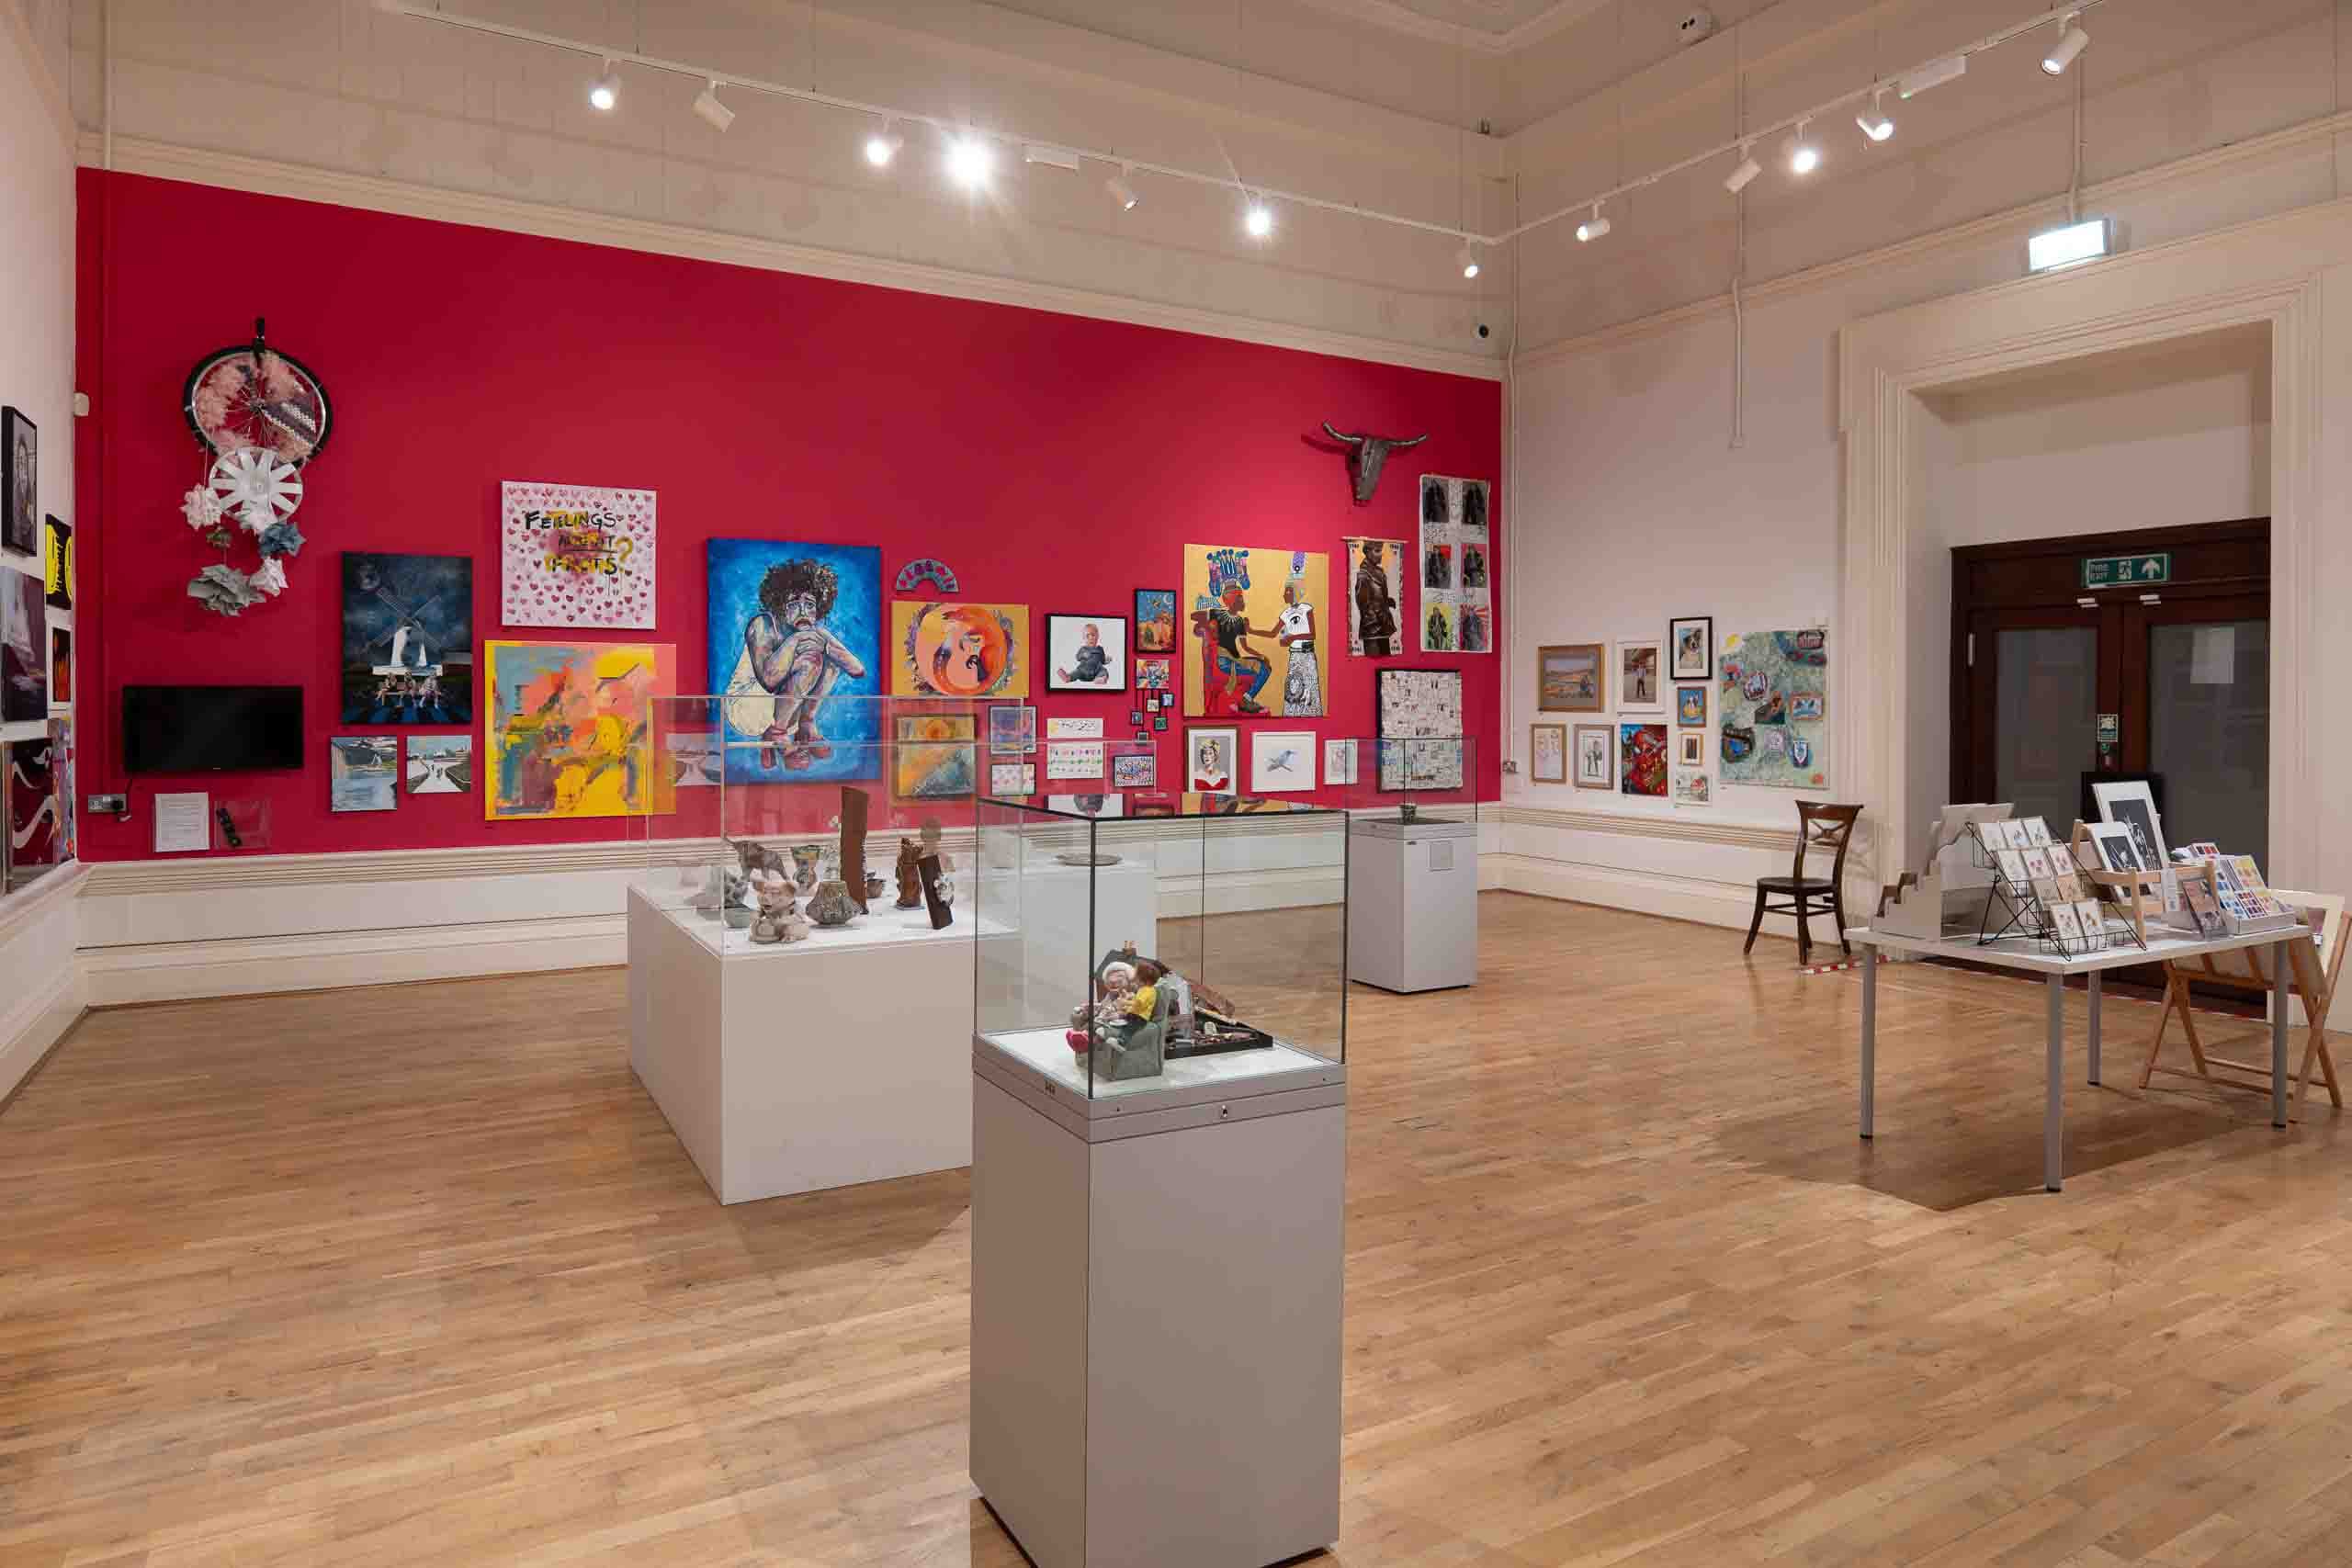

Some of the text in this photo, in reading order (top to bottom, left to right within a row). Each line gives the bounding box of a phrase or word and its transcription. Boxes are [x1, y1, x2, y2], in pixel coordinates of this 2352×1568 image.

[525, 510, 616, 532] FEELINGS
[2089, 563, 2110, 572] FIRE
[2089, 572, 2110, 582] EXIT
